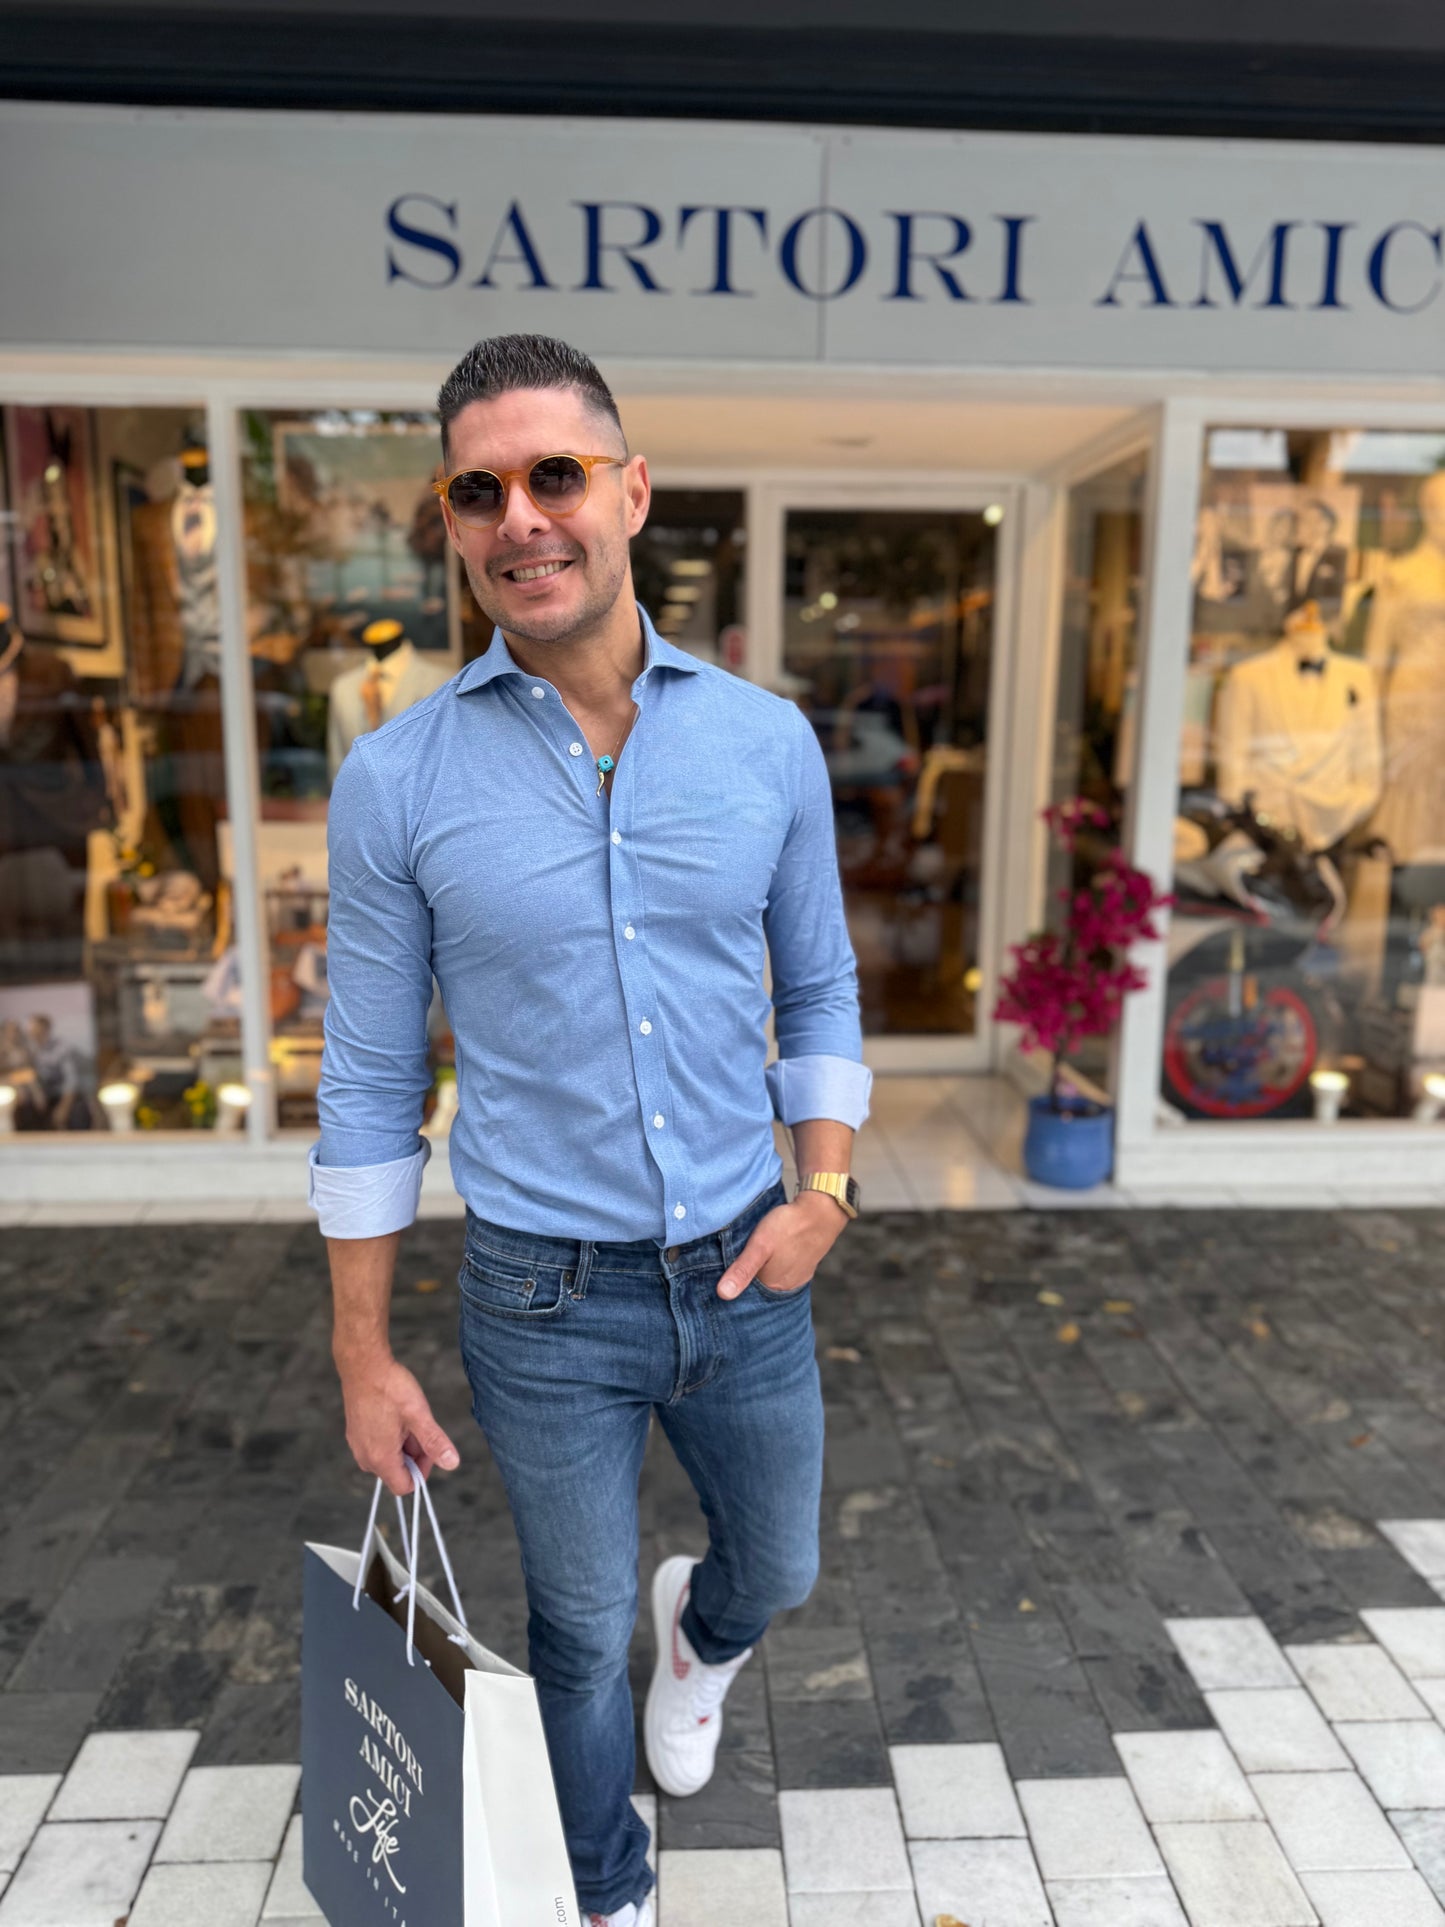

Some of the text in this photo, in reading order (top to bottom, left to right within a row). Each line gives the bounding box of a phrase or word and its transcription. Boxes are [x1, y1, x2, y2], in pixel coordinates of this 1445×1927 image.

[385, 192, 1445, 314] SARTORI AMIC
[344, 1677, 424, 1796] SARTORI
[359, 1734, 411, 1818] AMICI
[349, 1788, 406, 1894] Life
